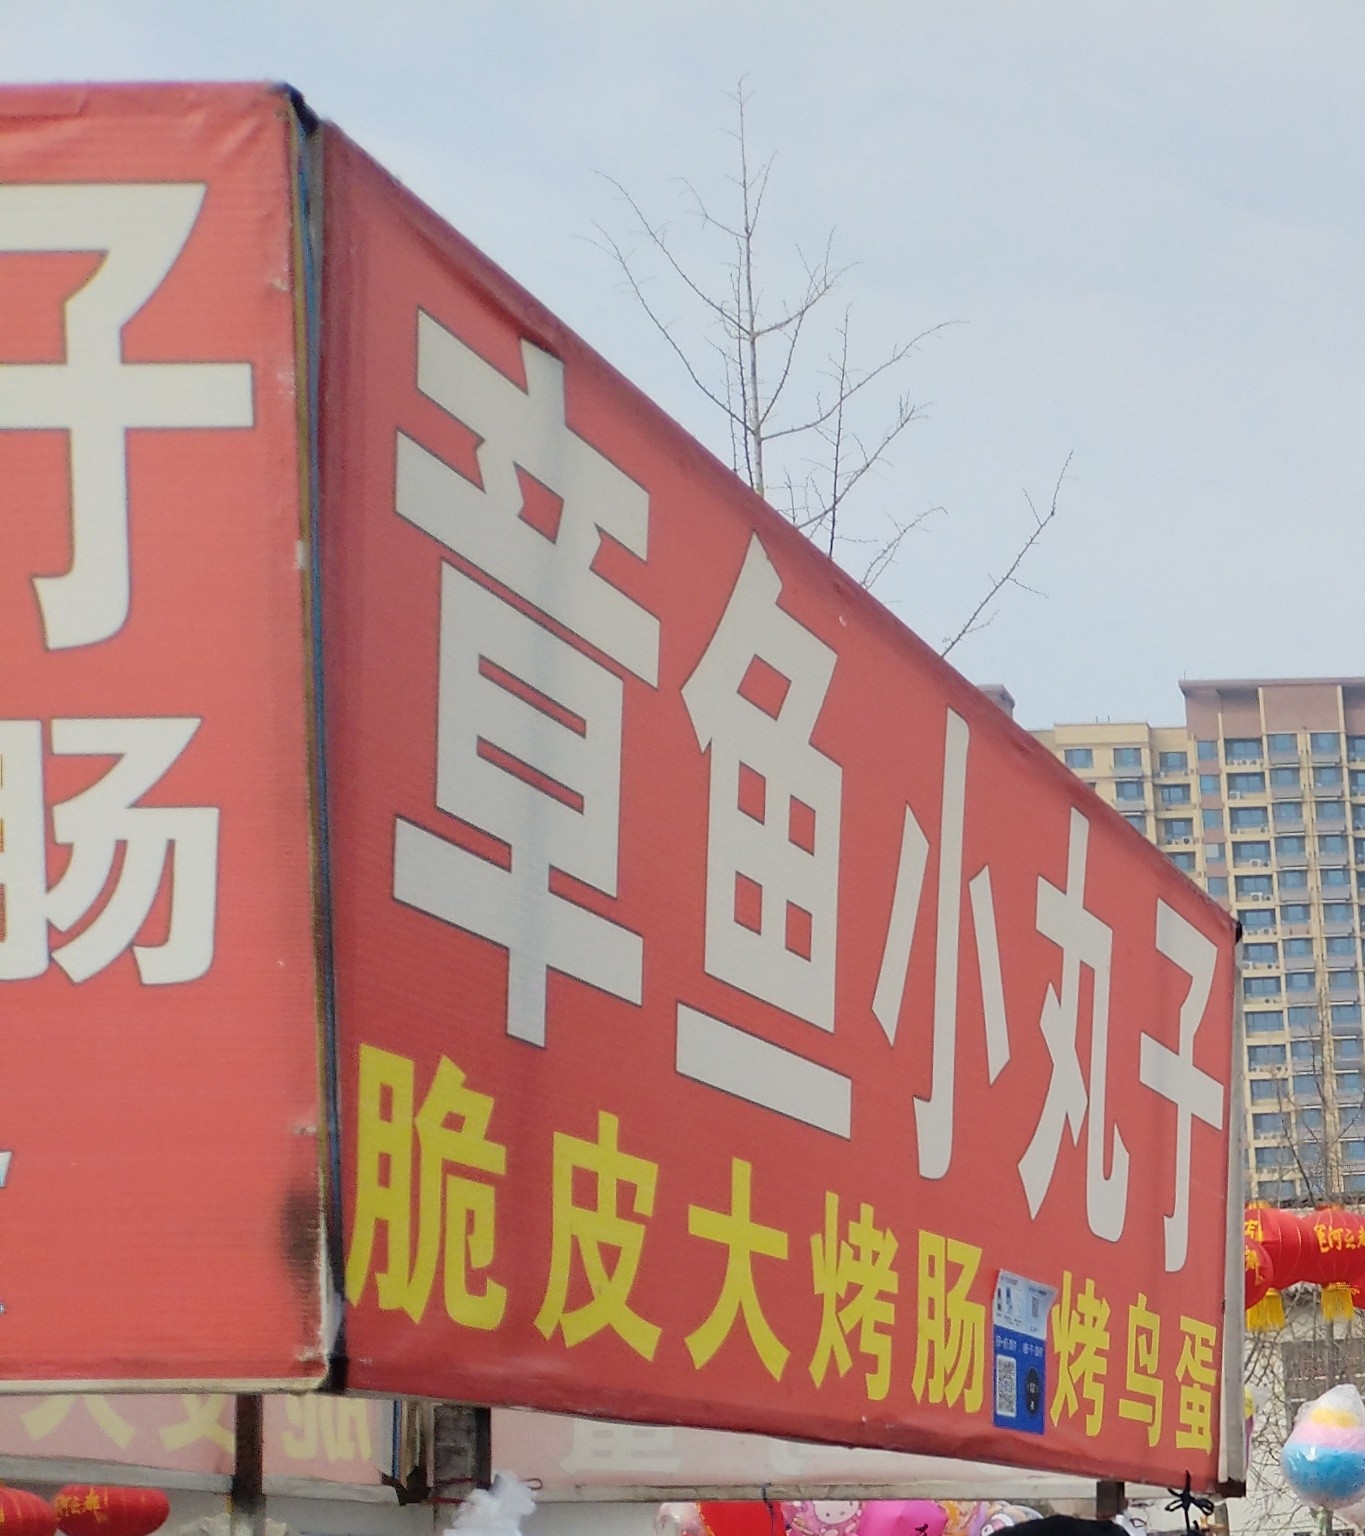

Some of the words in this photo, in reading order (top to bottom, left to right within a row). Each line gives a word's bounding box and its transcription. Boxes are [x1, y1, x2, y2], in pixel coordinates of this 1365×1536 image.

[390, 306, 1226, 1273] 章鱼小丸子
[346, 1043, 988, 1416] 脆皮大烤肠
[1048, 1268, 1220, 1458] 烤鸟蛋
